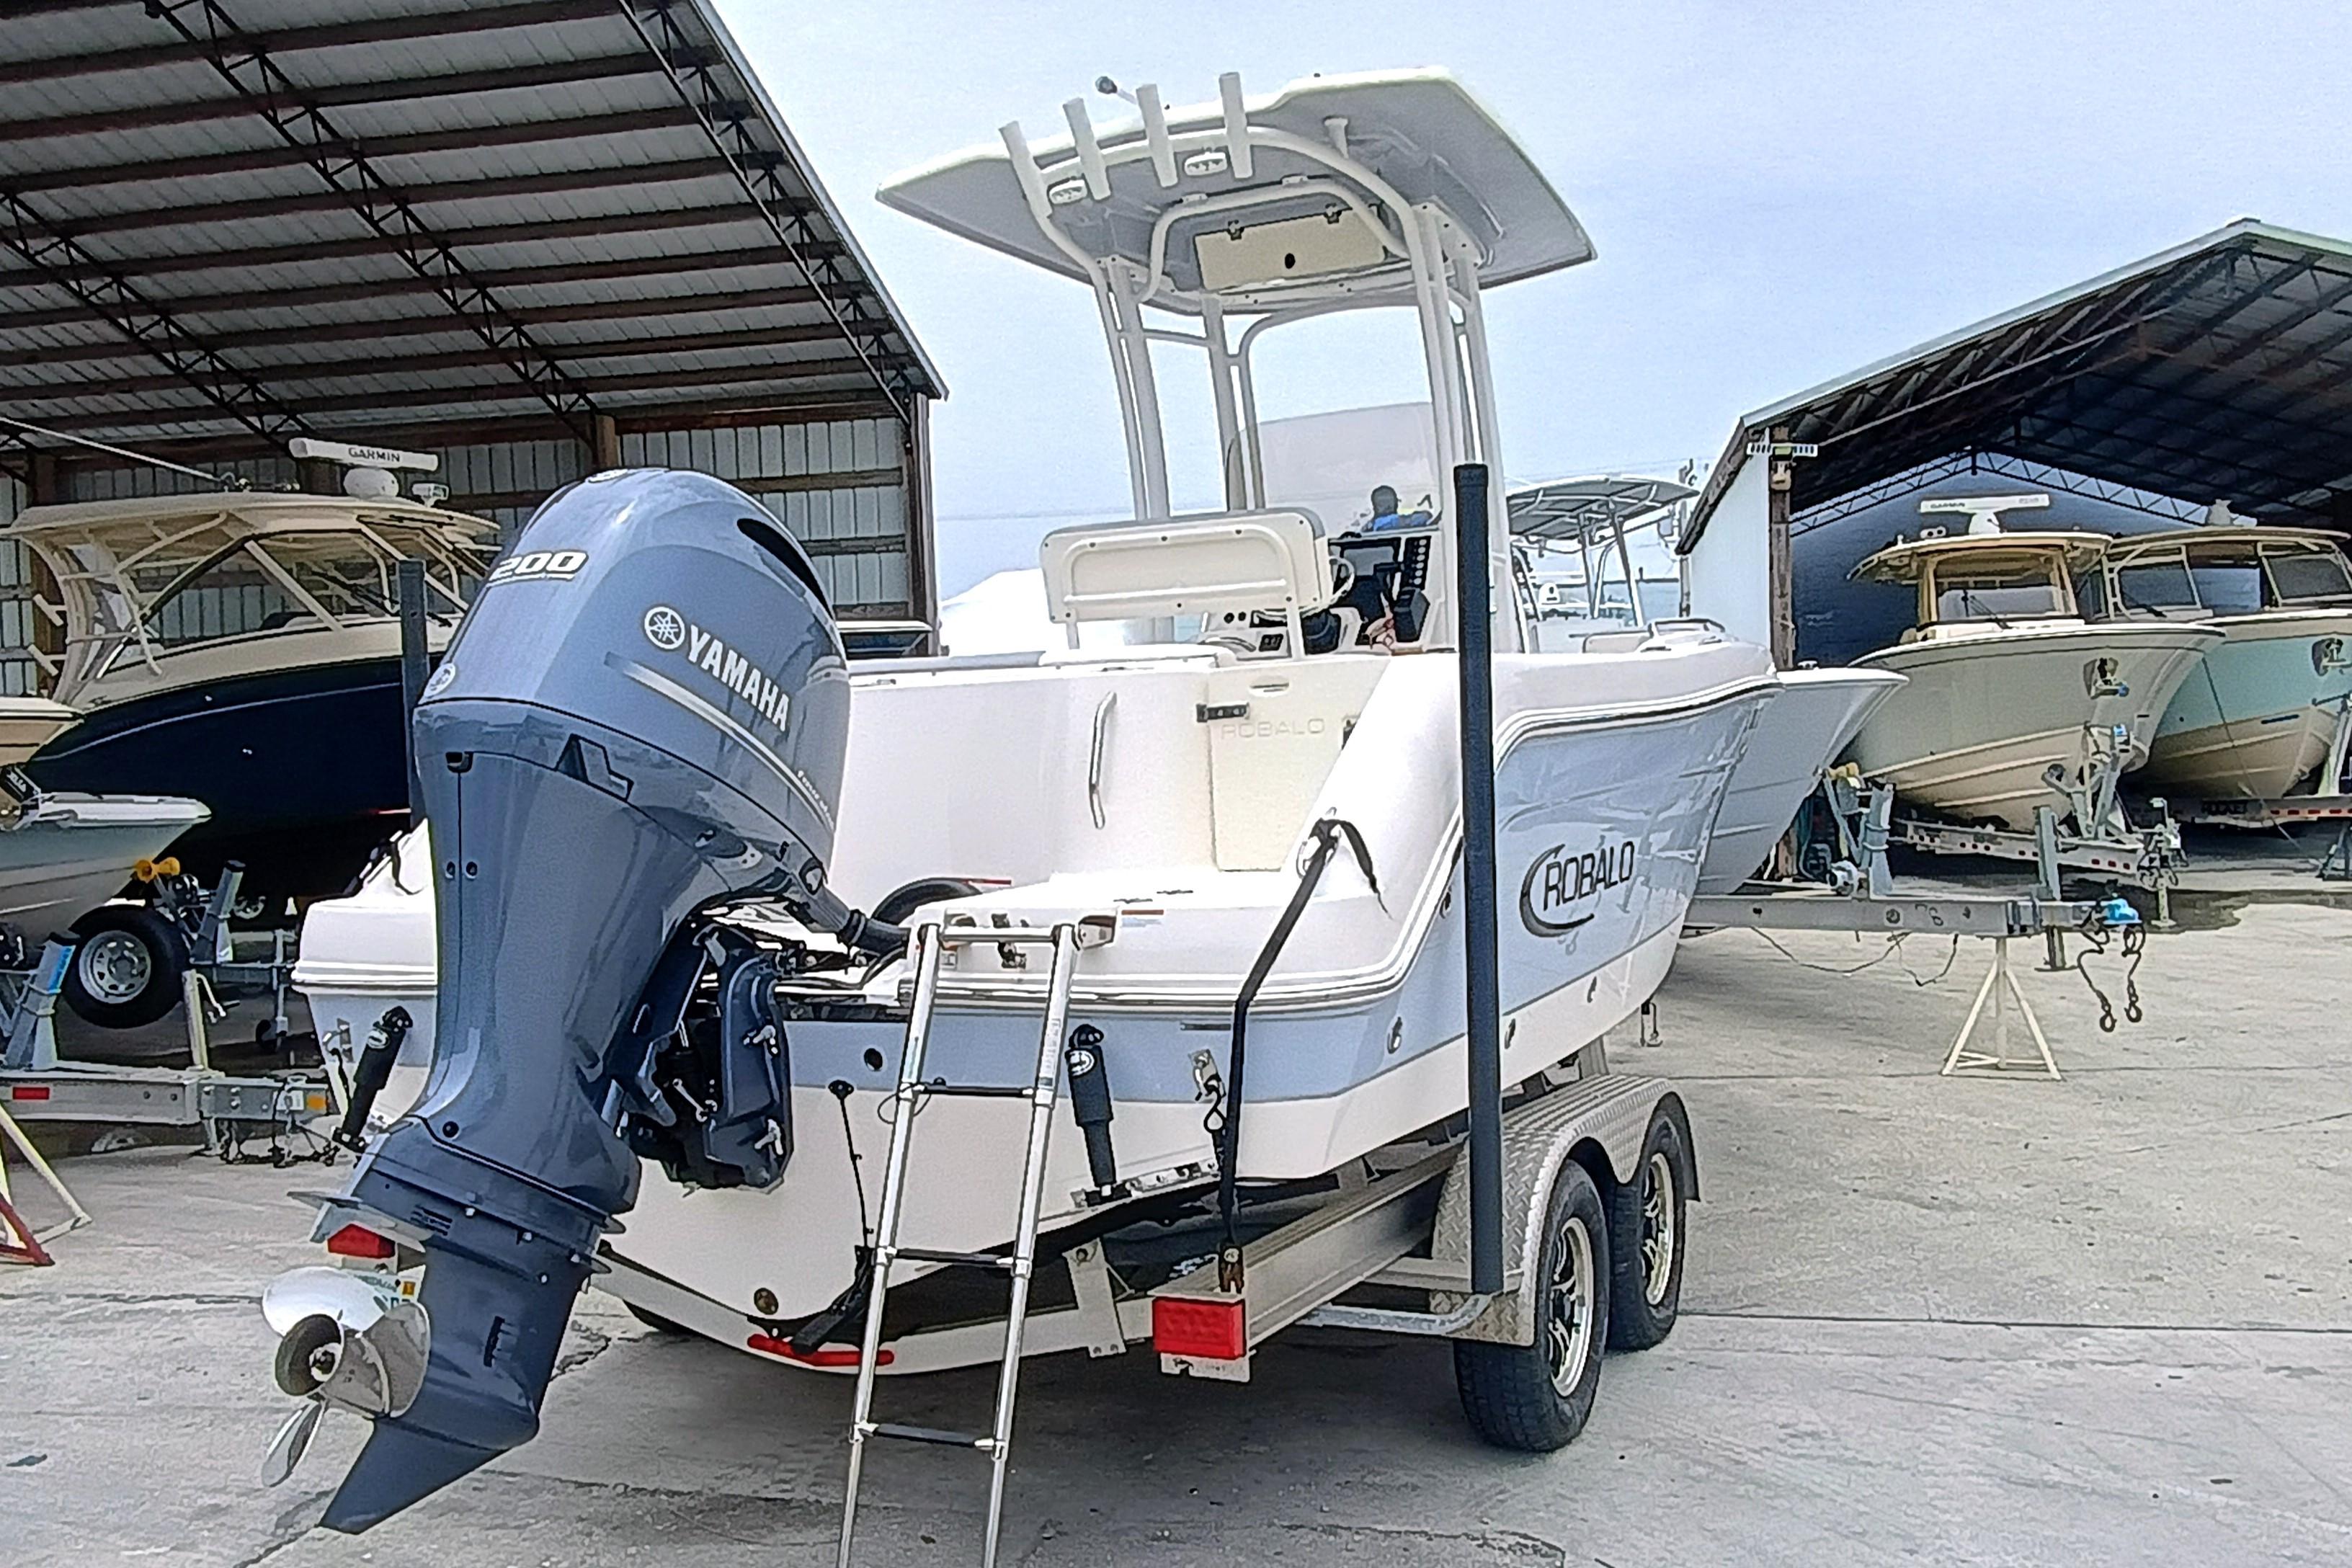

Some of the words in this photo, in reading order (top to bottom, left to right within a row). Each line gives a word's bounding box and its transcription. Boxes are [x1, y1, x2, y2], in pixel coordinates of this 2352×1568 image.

[348, 447, 400, 462] GARMIN
[488, 551, 588, 582] 200
[688, 624, 790, 732] YAMAHA
[1221, 718, 1325, 740] ROBALO
[1543, 840, 1635, 912] ROBALO
